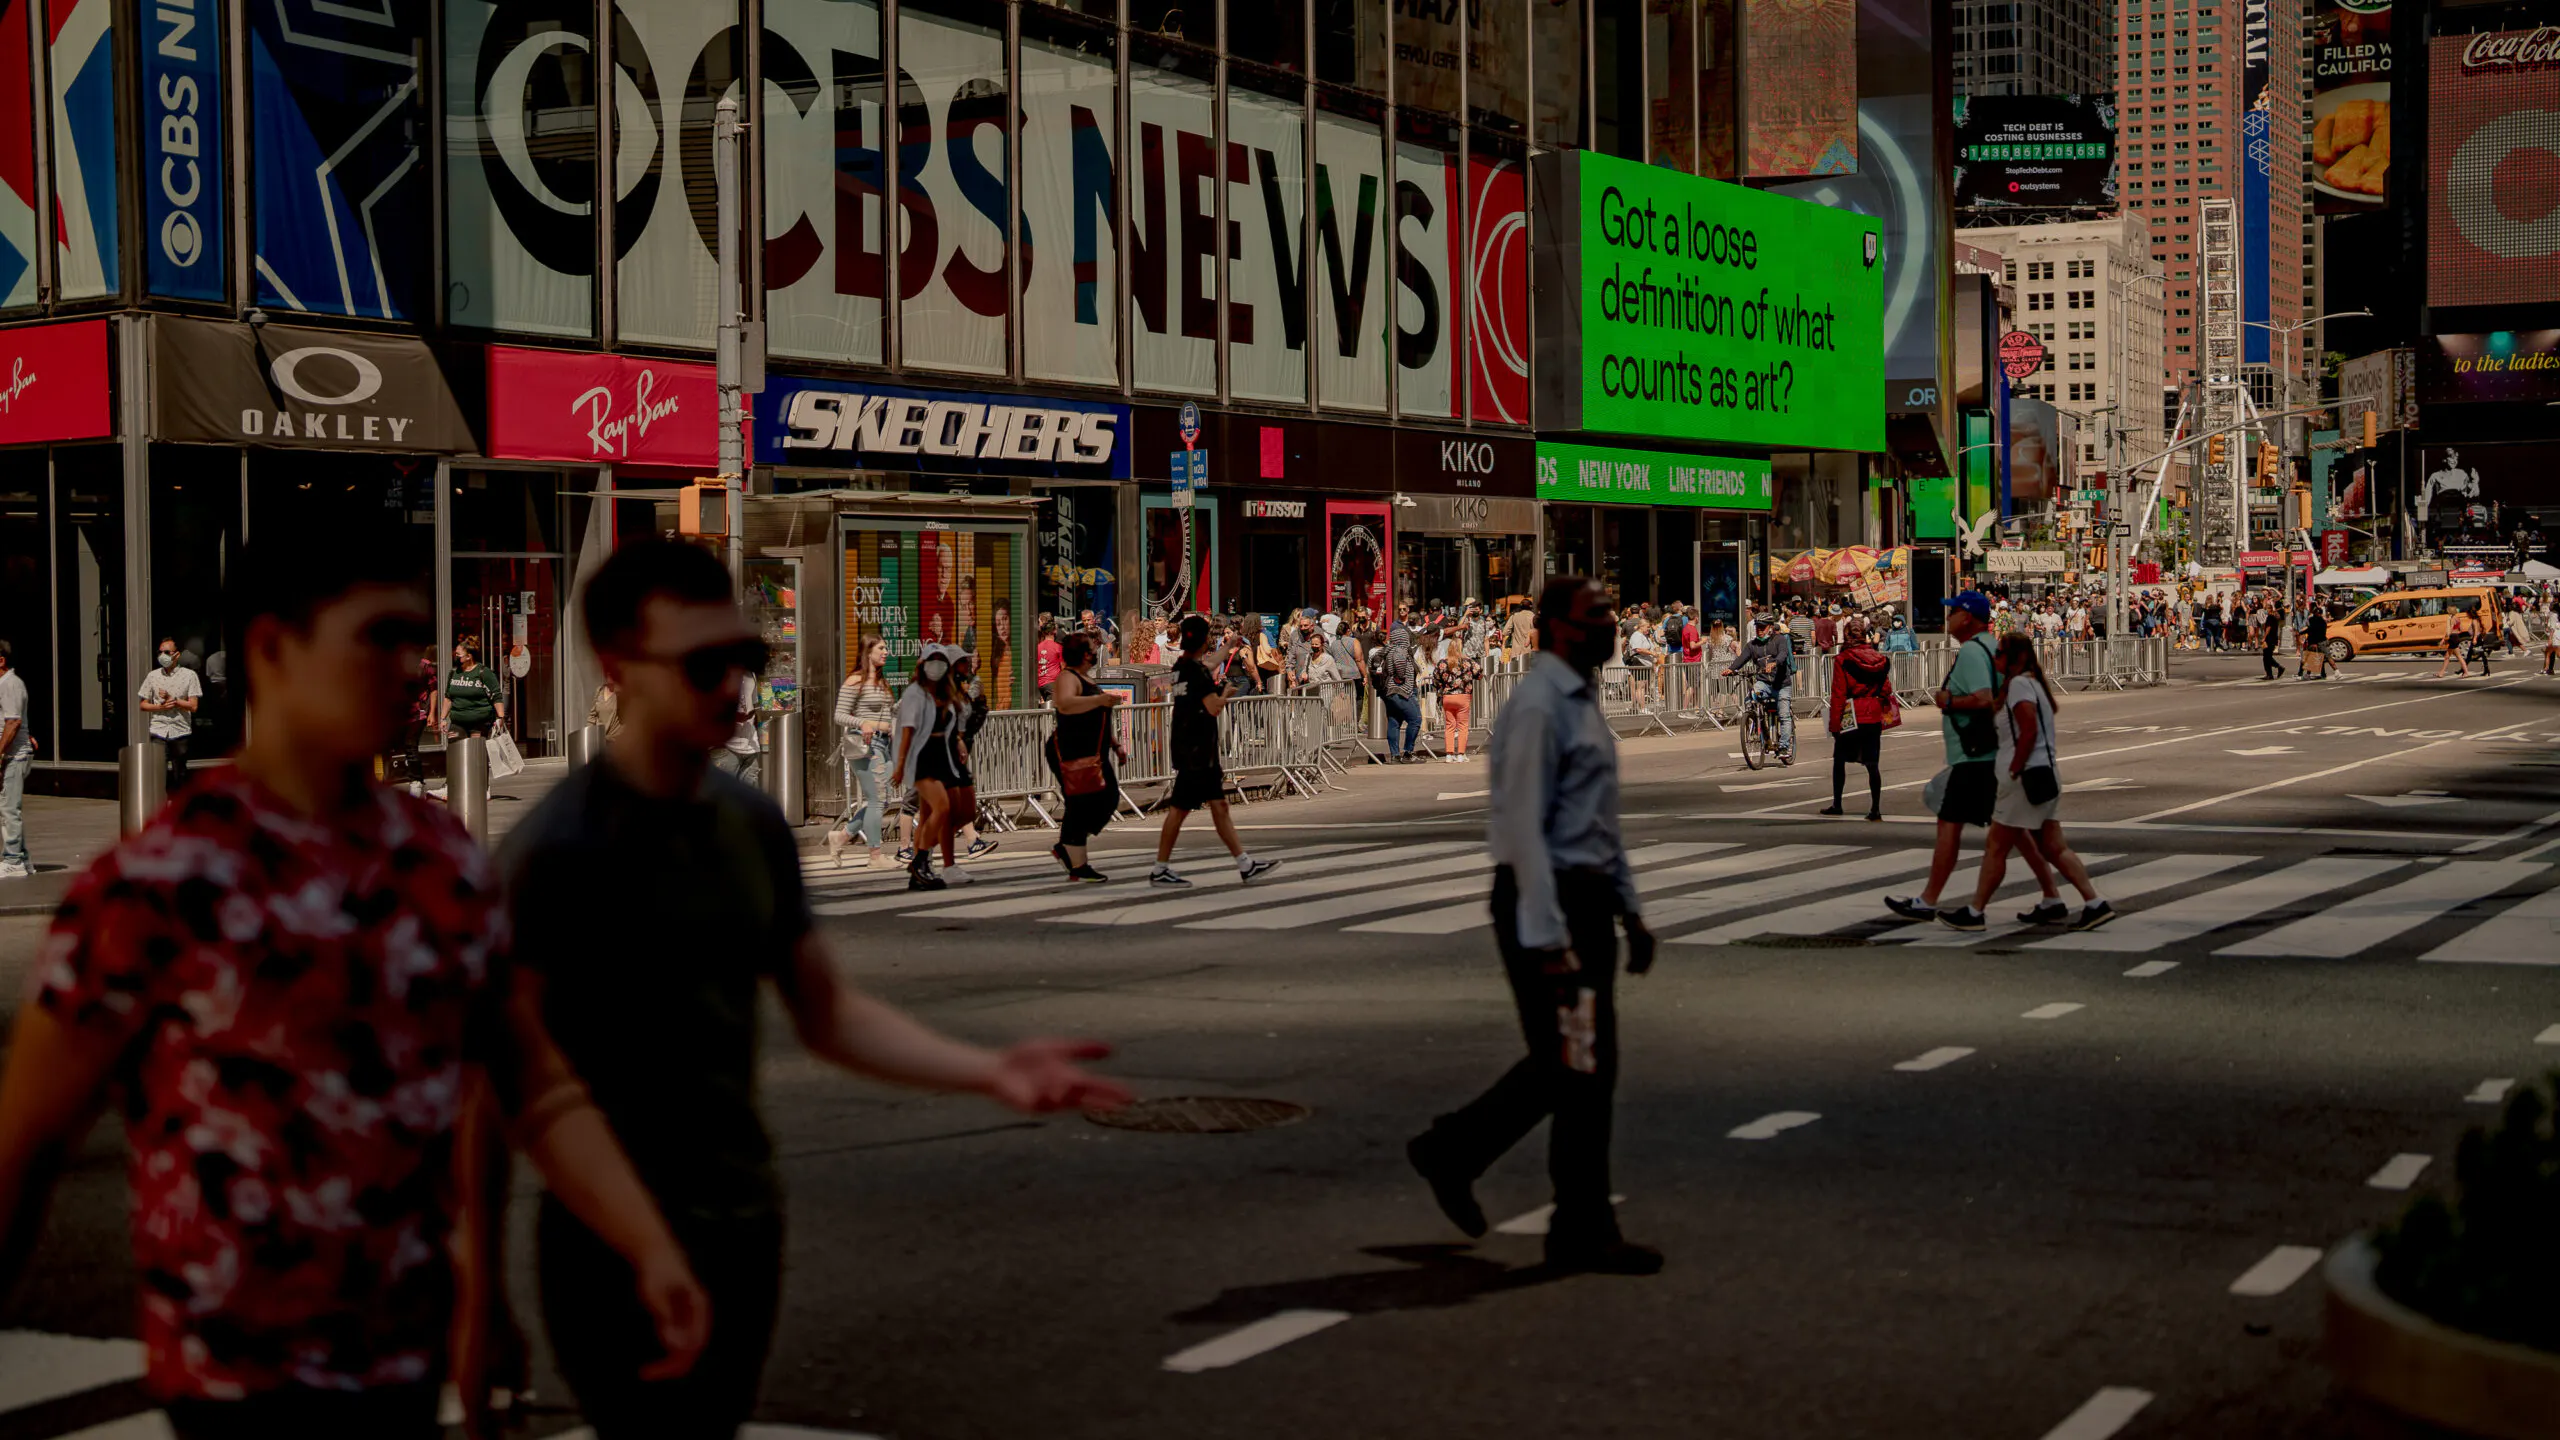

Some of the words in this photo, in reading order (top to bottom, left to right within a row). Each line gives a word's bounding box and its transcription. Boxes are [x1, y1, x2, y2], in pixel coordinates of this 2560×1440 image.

[156, 0, 197, 61] N
[2317, 58, 2392, 76] CAULIFLO
[2324, 44, 2376, 61] FILLED
[158, 73, 201, 209] CBS
[1984, 133, 2024, 142] COSTING
[2027, 132, 2083, 142] BUSINESSES
[2003, 123, 2027, 132] TECH
[2029, 123, 2052, 131] DEBT
[2055, 123, 2064, 131] IS
[680, 24, 1034, 318] CBS
[1071, 105, 1440, 370] NEWS
[2020, 183, 2060, 192] outsystems
[1600, 187, 1657, 249] Got
[1664, 212, 1680, 257] a
[1687, 202, 1758, 270] loose
[1600, 264, 1734, 338] definition
[1742, 289, 1769, 341] of
[1774, 294, 1837, 352] what
[2453, 356, 2471, 374] to
[2476, 353, 2505, 373] the
[2508, 351, 2560, 371] ladies
[0, 356, 37, 414] ay-Ban
[1602, 353, 1703, 405] counts
[1710, 372, 1738, 408] as
[1744, 360, 1794, 414] art?
[241, 407, 411, 443] OAKLEY
[572, 369, 679, 457] Ray-Ban
[782, 389, 1119, 465] SKECHERS
[1441, 440, 1495, 474] KIKO
[1456, 479, 1481, 488] MILANO
[1579, 459, 1613, 490] NEW
[1615, 462, 1651, 492] YORK
[1669, 466, 1697, 493] LINE
[1699, 468, 1746, 496] FRIENDS
[1451, 497, 1489, 520] KIKO
[1988, 554, 2063, 567] SWAROVSKI
[2327, 532, 2344, 563] tkts
[852, 586, 885, 605] ONLY
[852, 606, 908, 625] MURDERS
[882, 626, 891, 637] IN
[893, 626, 908, 637] THE
